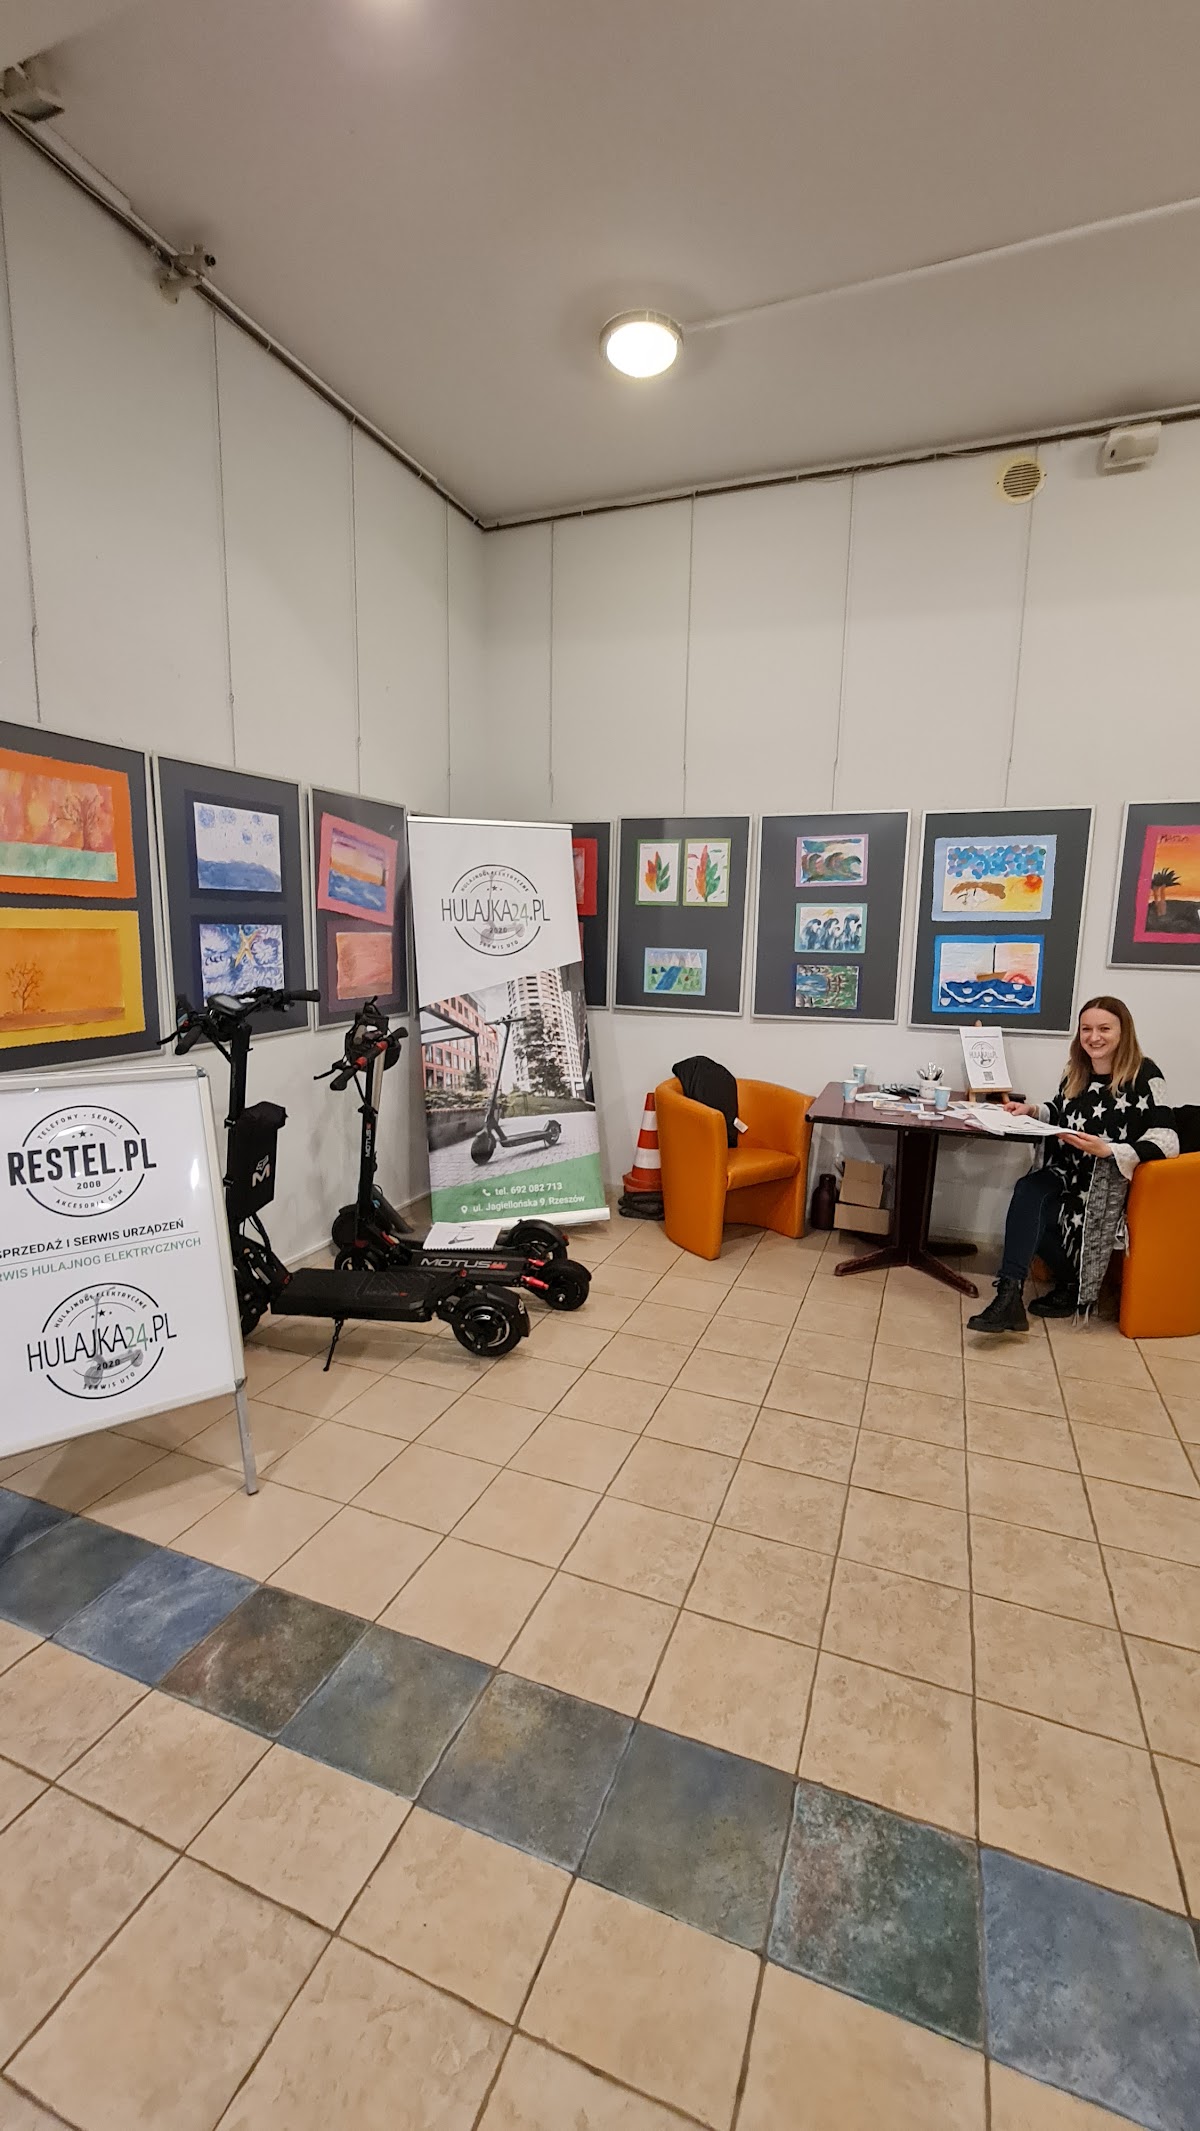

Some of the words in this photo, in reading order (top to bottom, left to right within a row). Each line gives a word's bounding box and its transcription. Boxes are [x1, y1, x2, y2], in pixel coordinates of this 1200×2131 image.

[441, 898, 551, 927] HULAJKA24.PL
[489, 926, 508, 934] 2020
[37, 1114, 78, 1140] TELEFONY
[91, 1113, 123, 1130] SERWIS
[7, 1138, 157, 1187] RESTEL.PL
[108, 1189, 123, 1201] GSM
[495, 1187, 509, 1196] tel.
[510, 1185, 527, 1194] 692
[528, 1184, 544, 1193] 082
[546, 1182, 562, 1191] 713
[473, 1203, 483, 1212] ul.
[486, 1198, 538, 1212] Jagiellońska
[549, 1195, 585, 1205] Rzeszów
[0, 1238, 63, 1259] PRZEDAŻ
[66, 1239, 70, 1248] I
[73, 1230, 120, 1247] SERWIS
[123, 1218, 184, 1238] URZĄDZEŃ
[31, 1255, 101, 1276] HULAJNOG
[104, 1237, 202, 1263] ELEKTRYCZNYCH
[420, 1258, 492, 1269] MOTUS
[96, 1290, 148, 1309] ELEKTRYCZNE
[26, 1312, 178, 1372] HULAJKA24.PL
[97, 1358, 121, 1371] 2020
[83, 1381, 116, 1390] SERWIS
[120, 1371, 135, 1384] UTO
